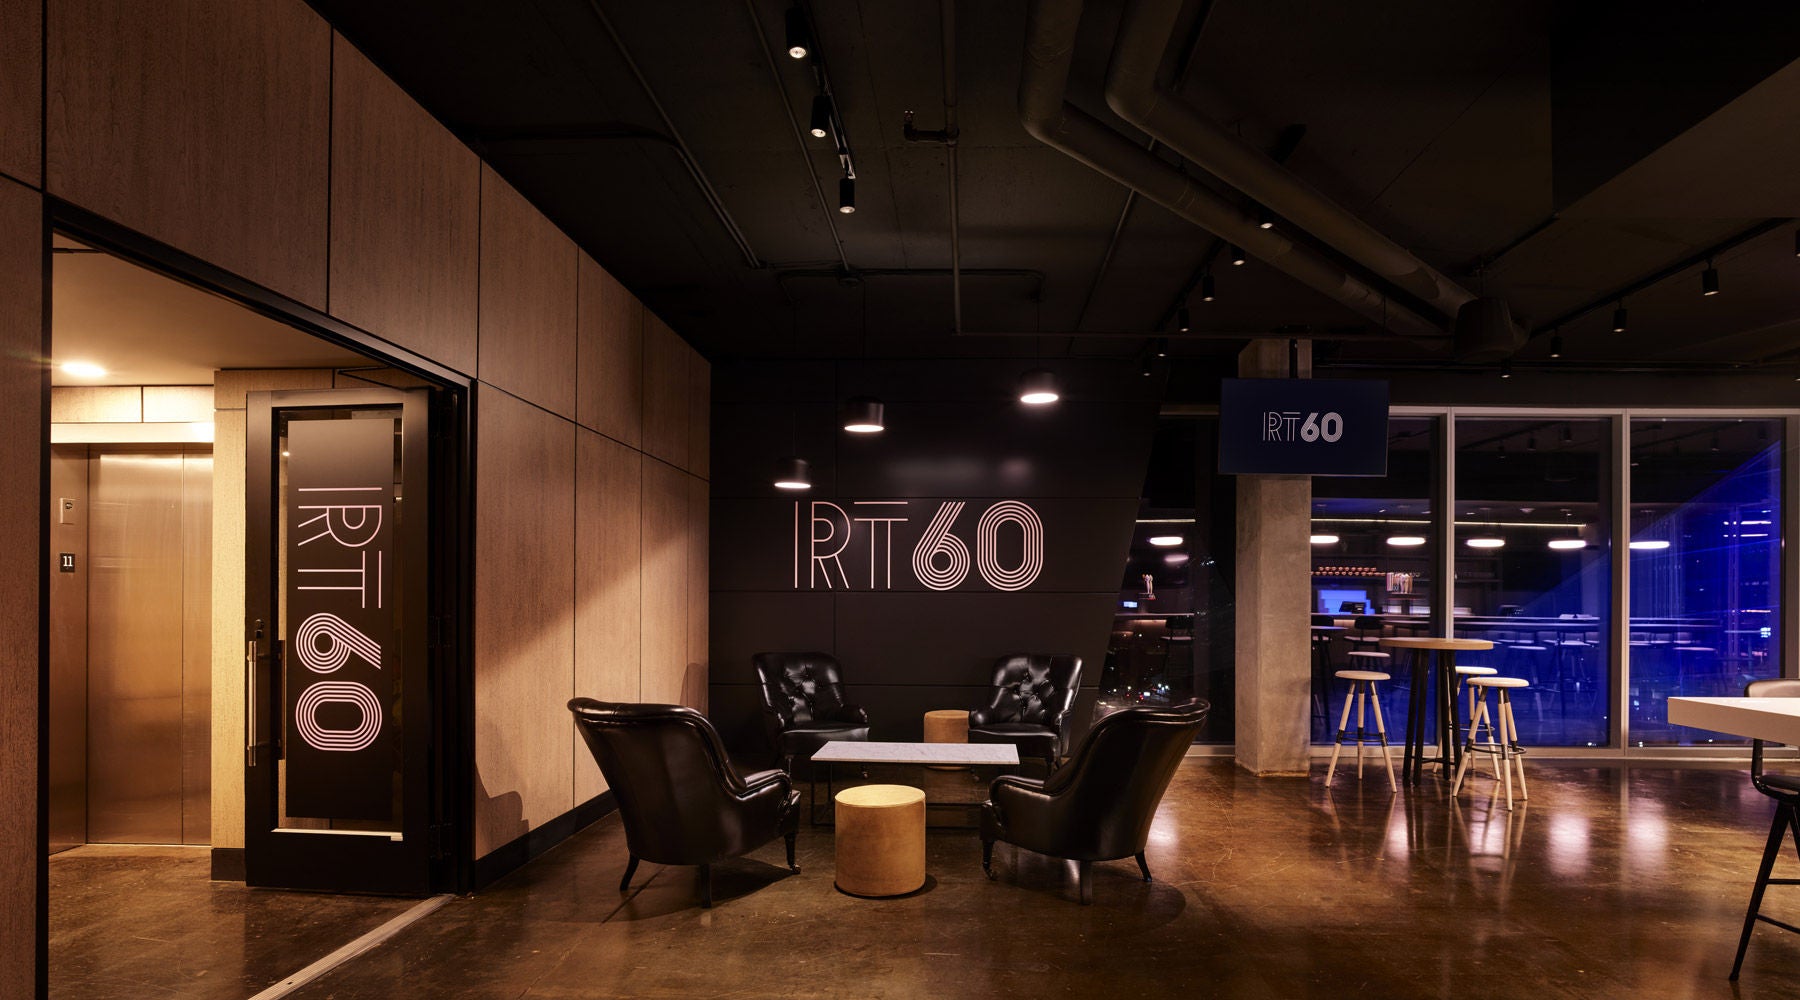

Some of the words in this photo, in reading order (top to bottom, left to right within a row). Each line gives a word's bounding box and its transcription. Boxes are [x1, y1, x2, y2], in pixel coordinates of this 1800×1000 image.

[1262, 411, 1344, 443] RT60
[63, 555, 73, 567] 11
[794, 500, 1044, 591] RT60
[295, 487, 383, 752] RT60
